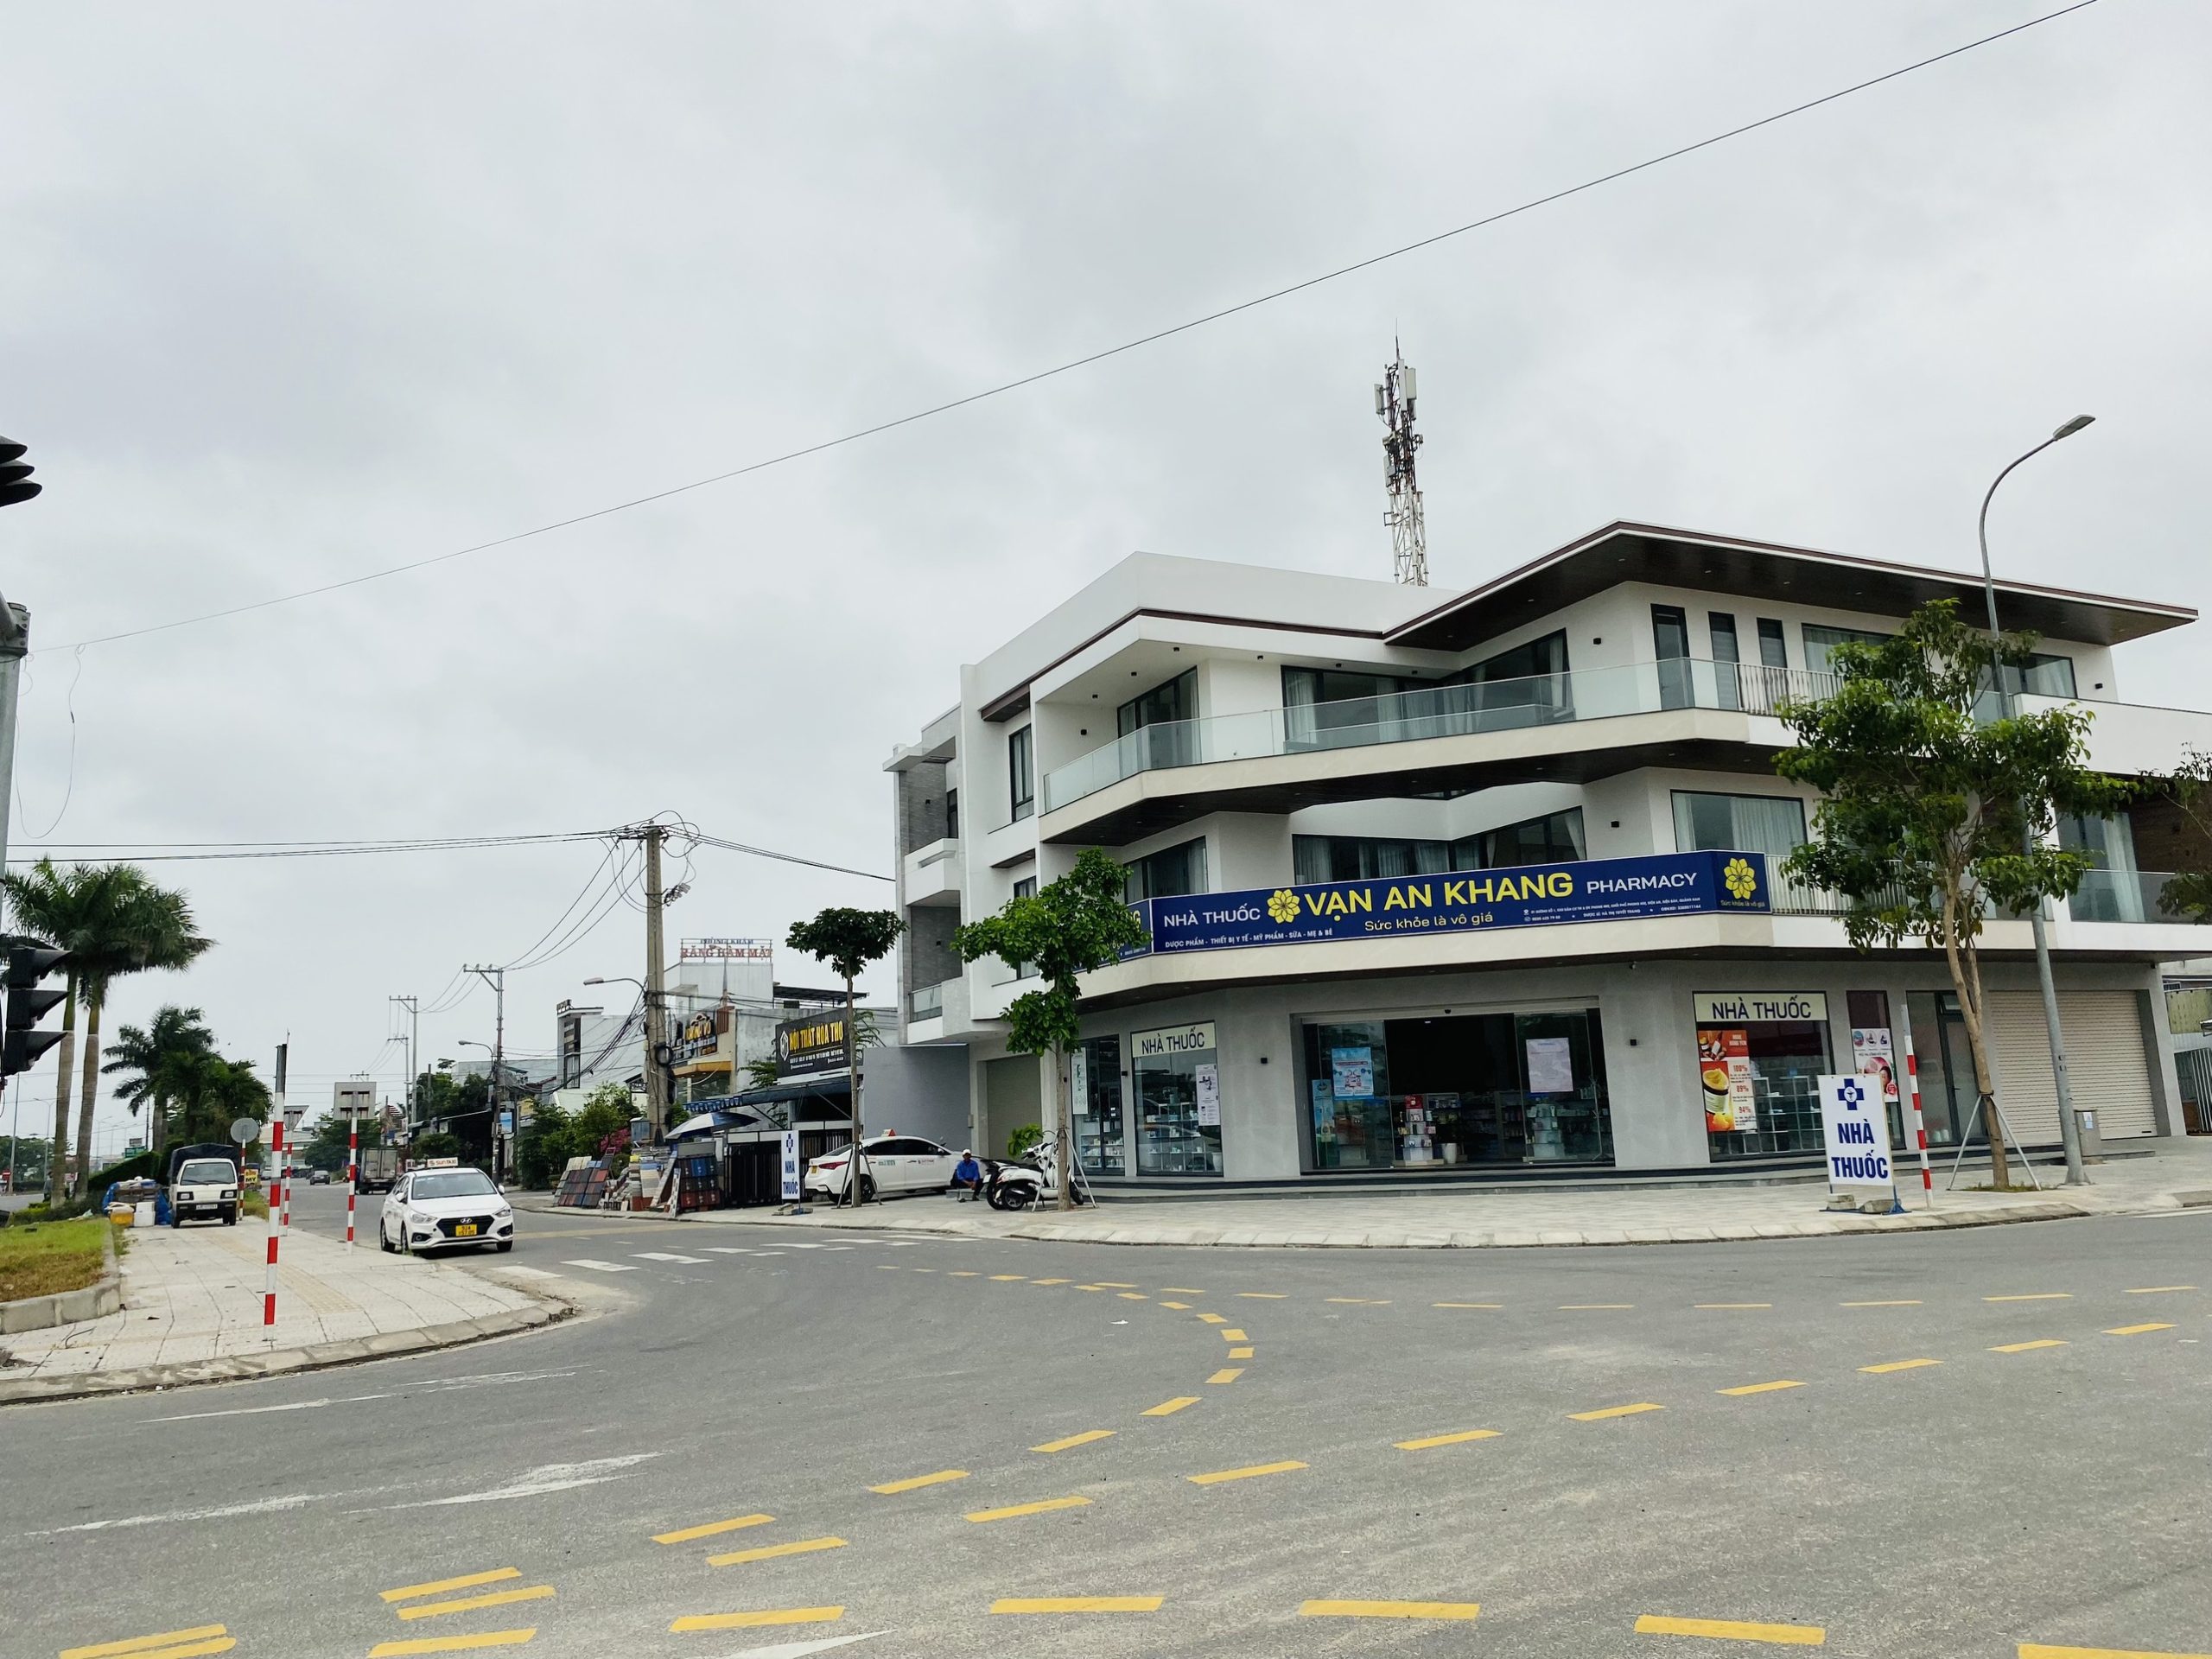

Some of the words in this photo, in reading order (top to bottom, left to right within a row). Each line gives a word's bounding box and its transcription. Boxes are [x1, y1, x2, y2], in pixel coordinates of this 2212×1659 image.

[1586, 872, 1697, 893] PHARMACY
[1305, 888, 1372, 922] VẠN
[1383, 884, 1433, 911] AN
[1444, 872, 1573, 906] KHANG
[1164, 910, 1198, 927] NHÀ
[1203, 903, 1261, 925] THUỐC
[1364, 918, 1392, 931] Sức
[1396, 914, 1429, 929] khỏe
[1434, 914, 1446, 926] là
[1451, 914, 1467, 925] vô
[1471, 912, 1493, 925] giá
[1242, 933, 1249, 942] TẾ
[1325, 927, 1332, 936] BÉ
[681, 945, 714, 957] RĂNG
[748, 945, 773, 961] MẶT
[1711, 997, 1749, 1020] NHÀ
[1753, 995, 1811, 1020] THUỐC
[1141, 1033, 1164, 1054] NHÀ
[1166, 1026, 1205, 1051] THUỐC
[1838, 1119, 1874, 1144] NHÀ
[785, 1158, 795, 1173] NHÀ
[1831, 1150, 1888, 1179] THUỐC
[783, 1177, 798, 1194] THUỐC
